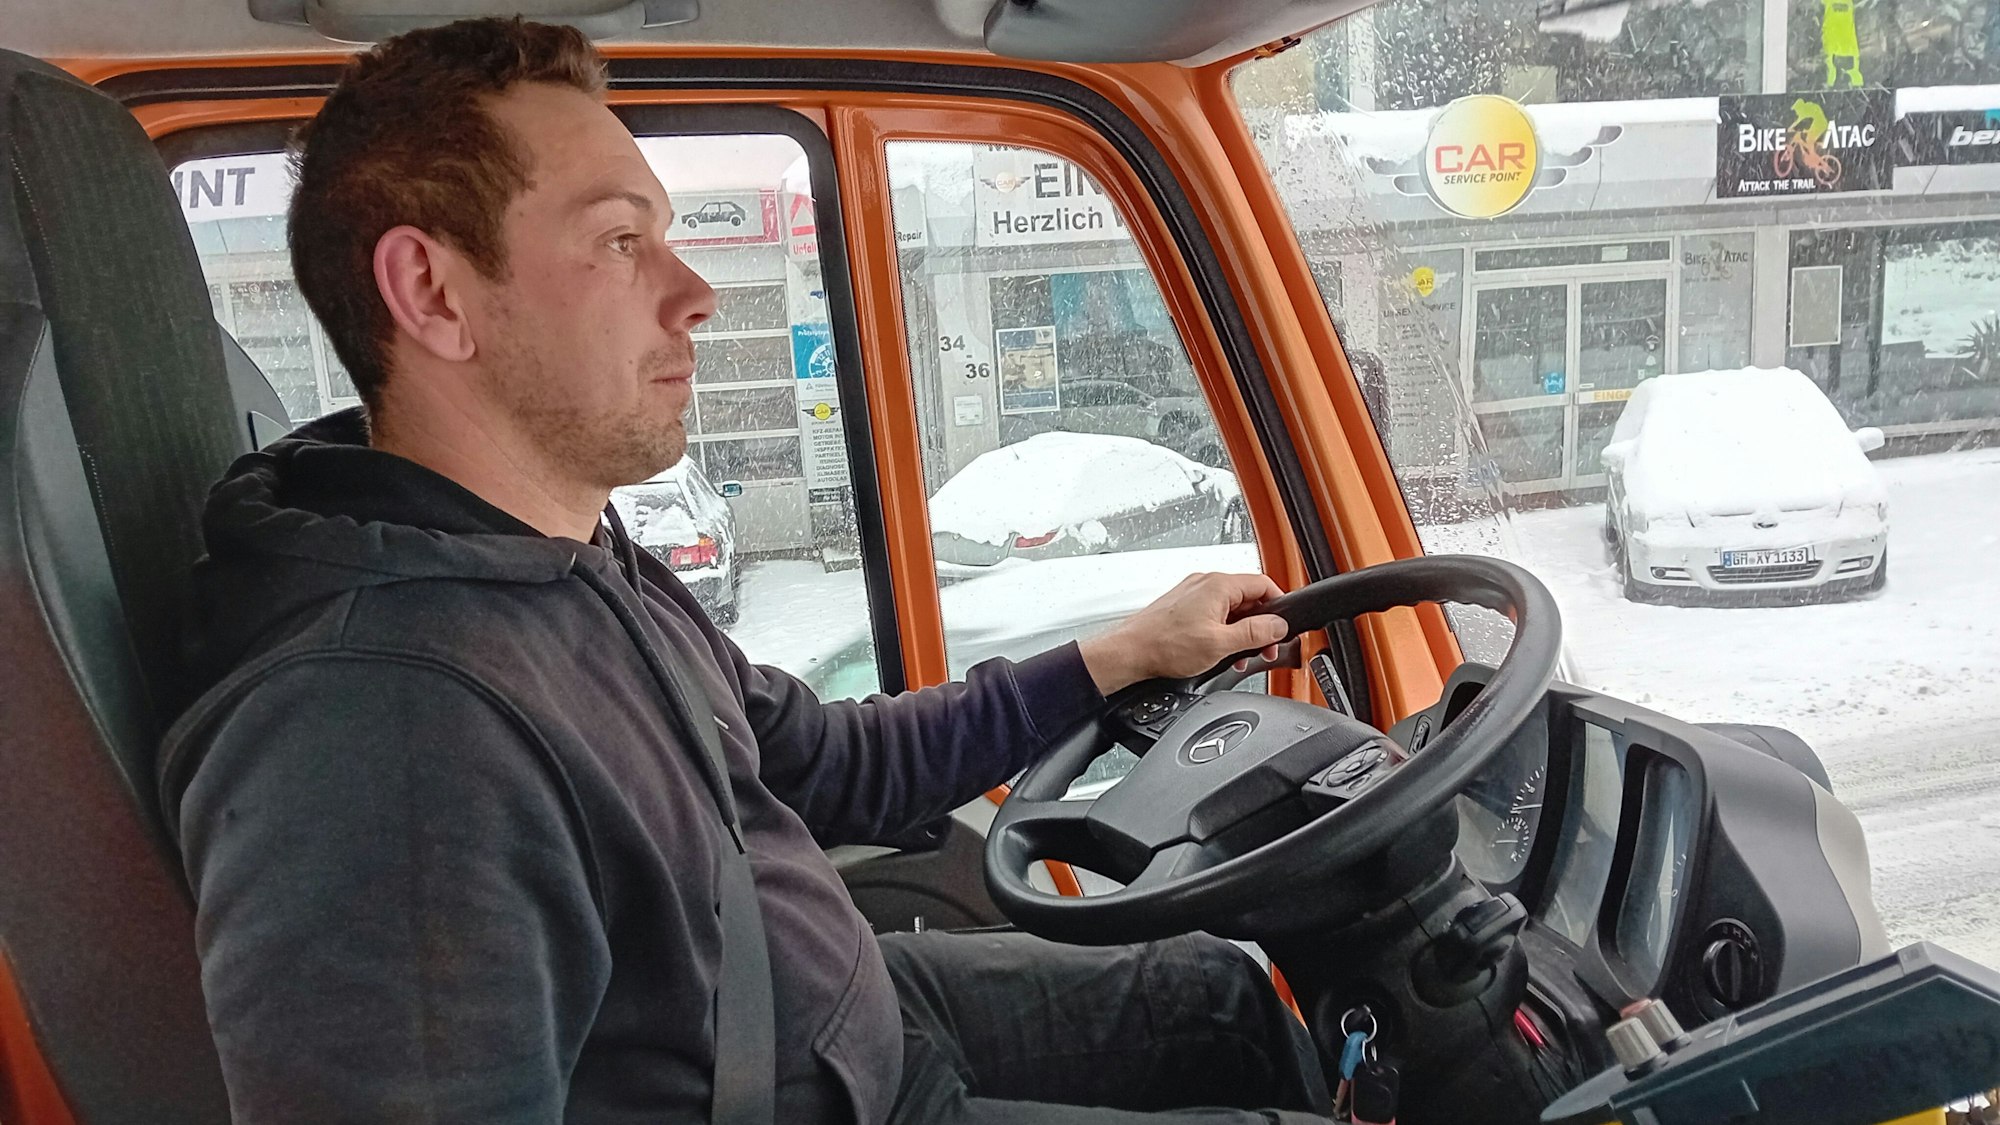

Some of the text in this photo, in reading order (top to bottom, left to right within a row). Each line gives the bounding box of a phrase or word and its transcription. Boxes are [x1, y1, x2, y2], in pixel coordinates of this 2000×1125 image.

[1822, 120, 1876, 149] ATAC
[1435, 142, 1526, 173] CAR
[1444, 171, 1521, 185] SERVICE POINT
[1773, 180, 1790, 190] THE
[993, 206, 1103, 234] Herzlich
[897, 229, 922, 242] Repair
[940, 334, 965, 351] 34
[965, 363, 990, 379] 36
[1774, 551, 1804, 564] 1133
